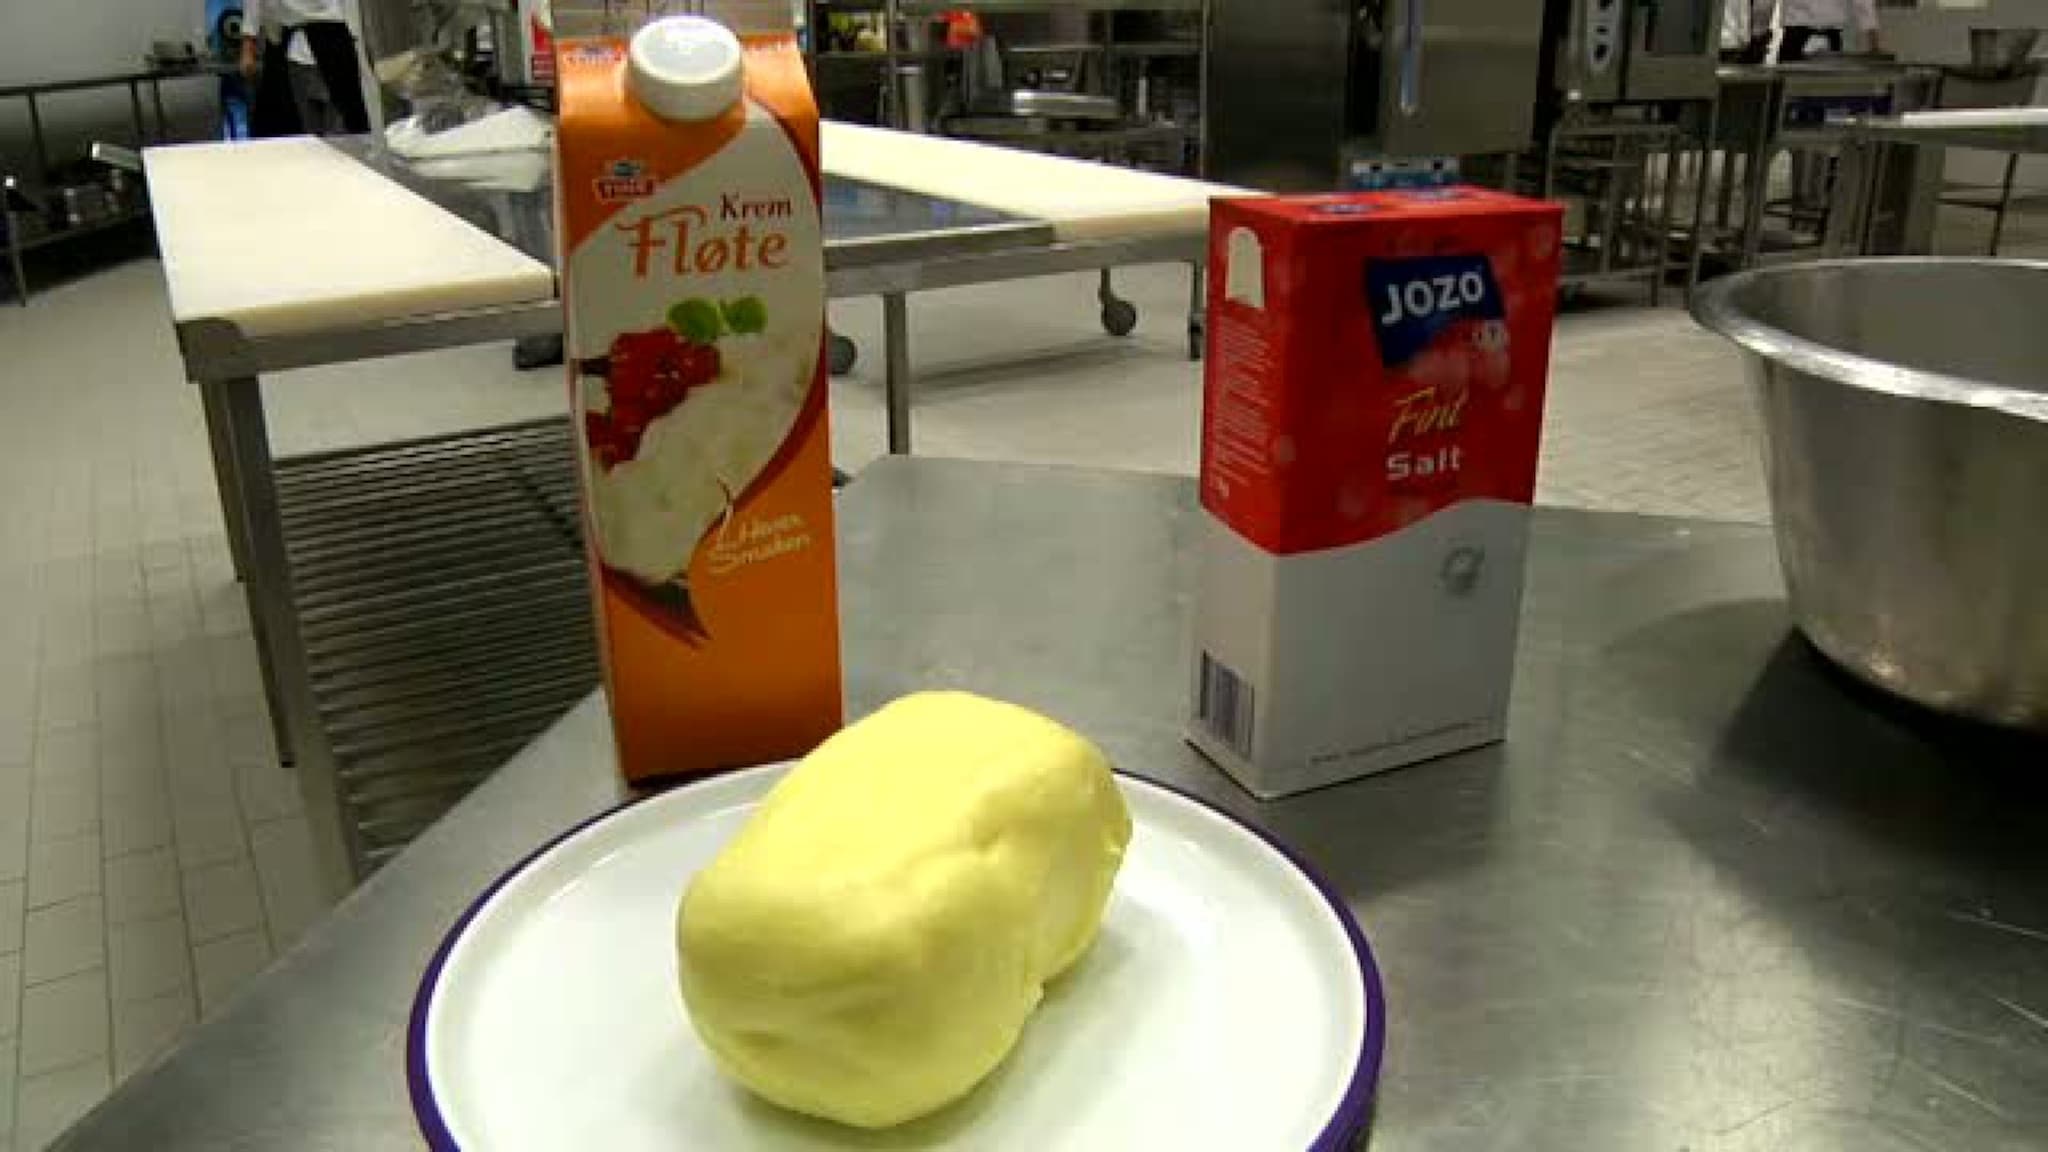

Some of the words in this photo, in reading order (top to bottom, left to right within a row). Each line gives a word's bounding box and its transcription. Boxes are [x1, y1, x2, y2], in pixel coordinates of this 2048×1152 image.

[721, 194, 792, 220] Krem
[615, 205, 789, 276] Fløte
[1381, 271, 1485, 325] JOZO
[1387, 385, 1469, 443] Fint
[1385, 447, 1461, 481] Salt
